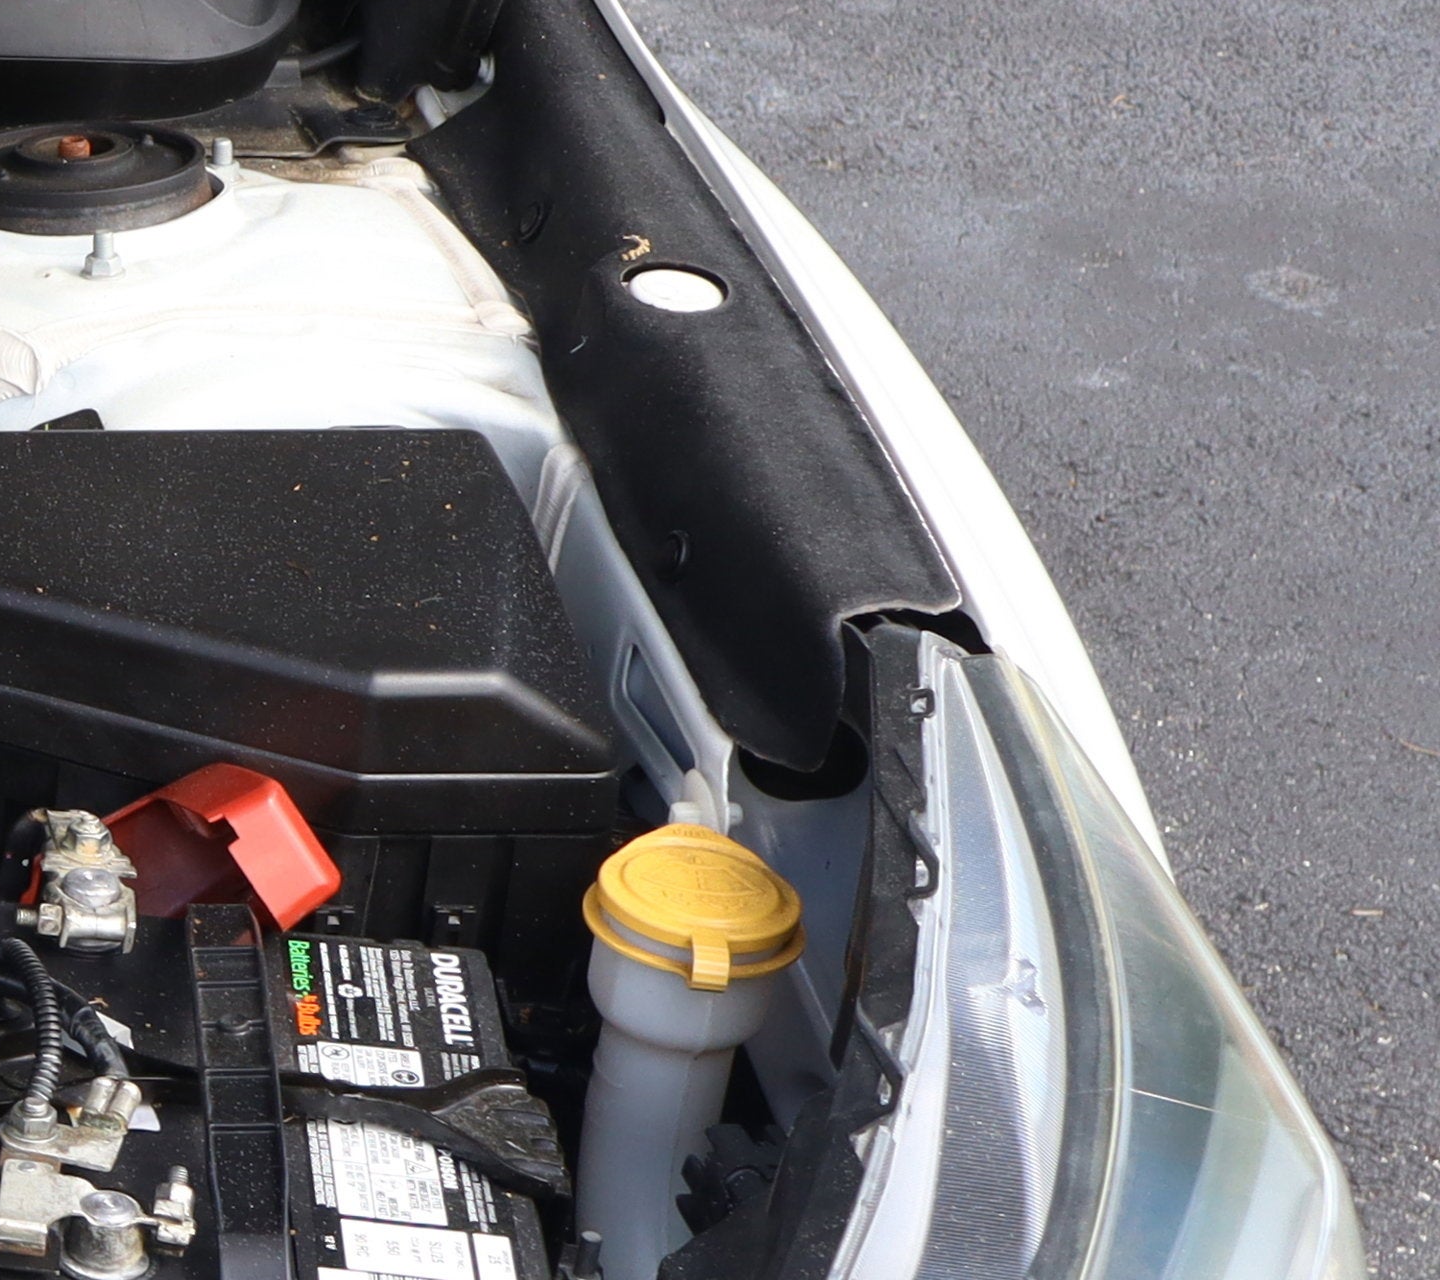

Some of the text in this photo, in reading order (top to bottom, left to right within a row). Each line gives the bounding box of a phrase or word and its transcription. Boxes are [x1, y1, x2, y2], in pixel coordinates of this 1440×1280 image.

[288, 939, 314, 991] Batteries
[296, 1001, 322, 1036] Bulbs
[430, 952, 474, 1046] DURACELL
